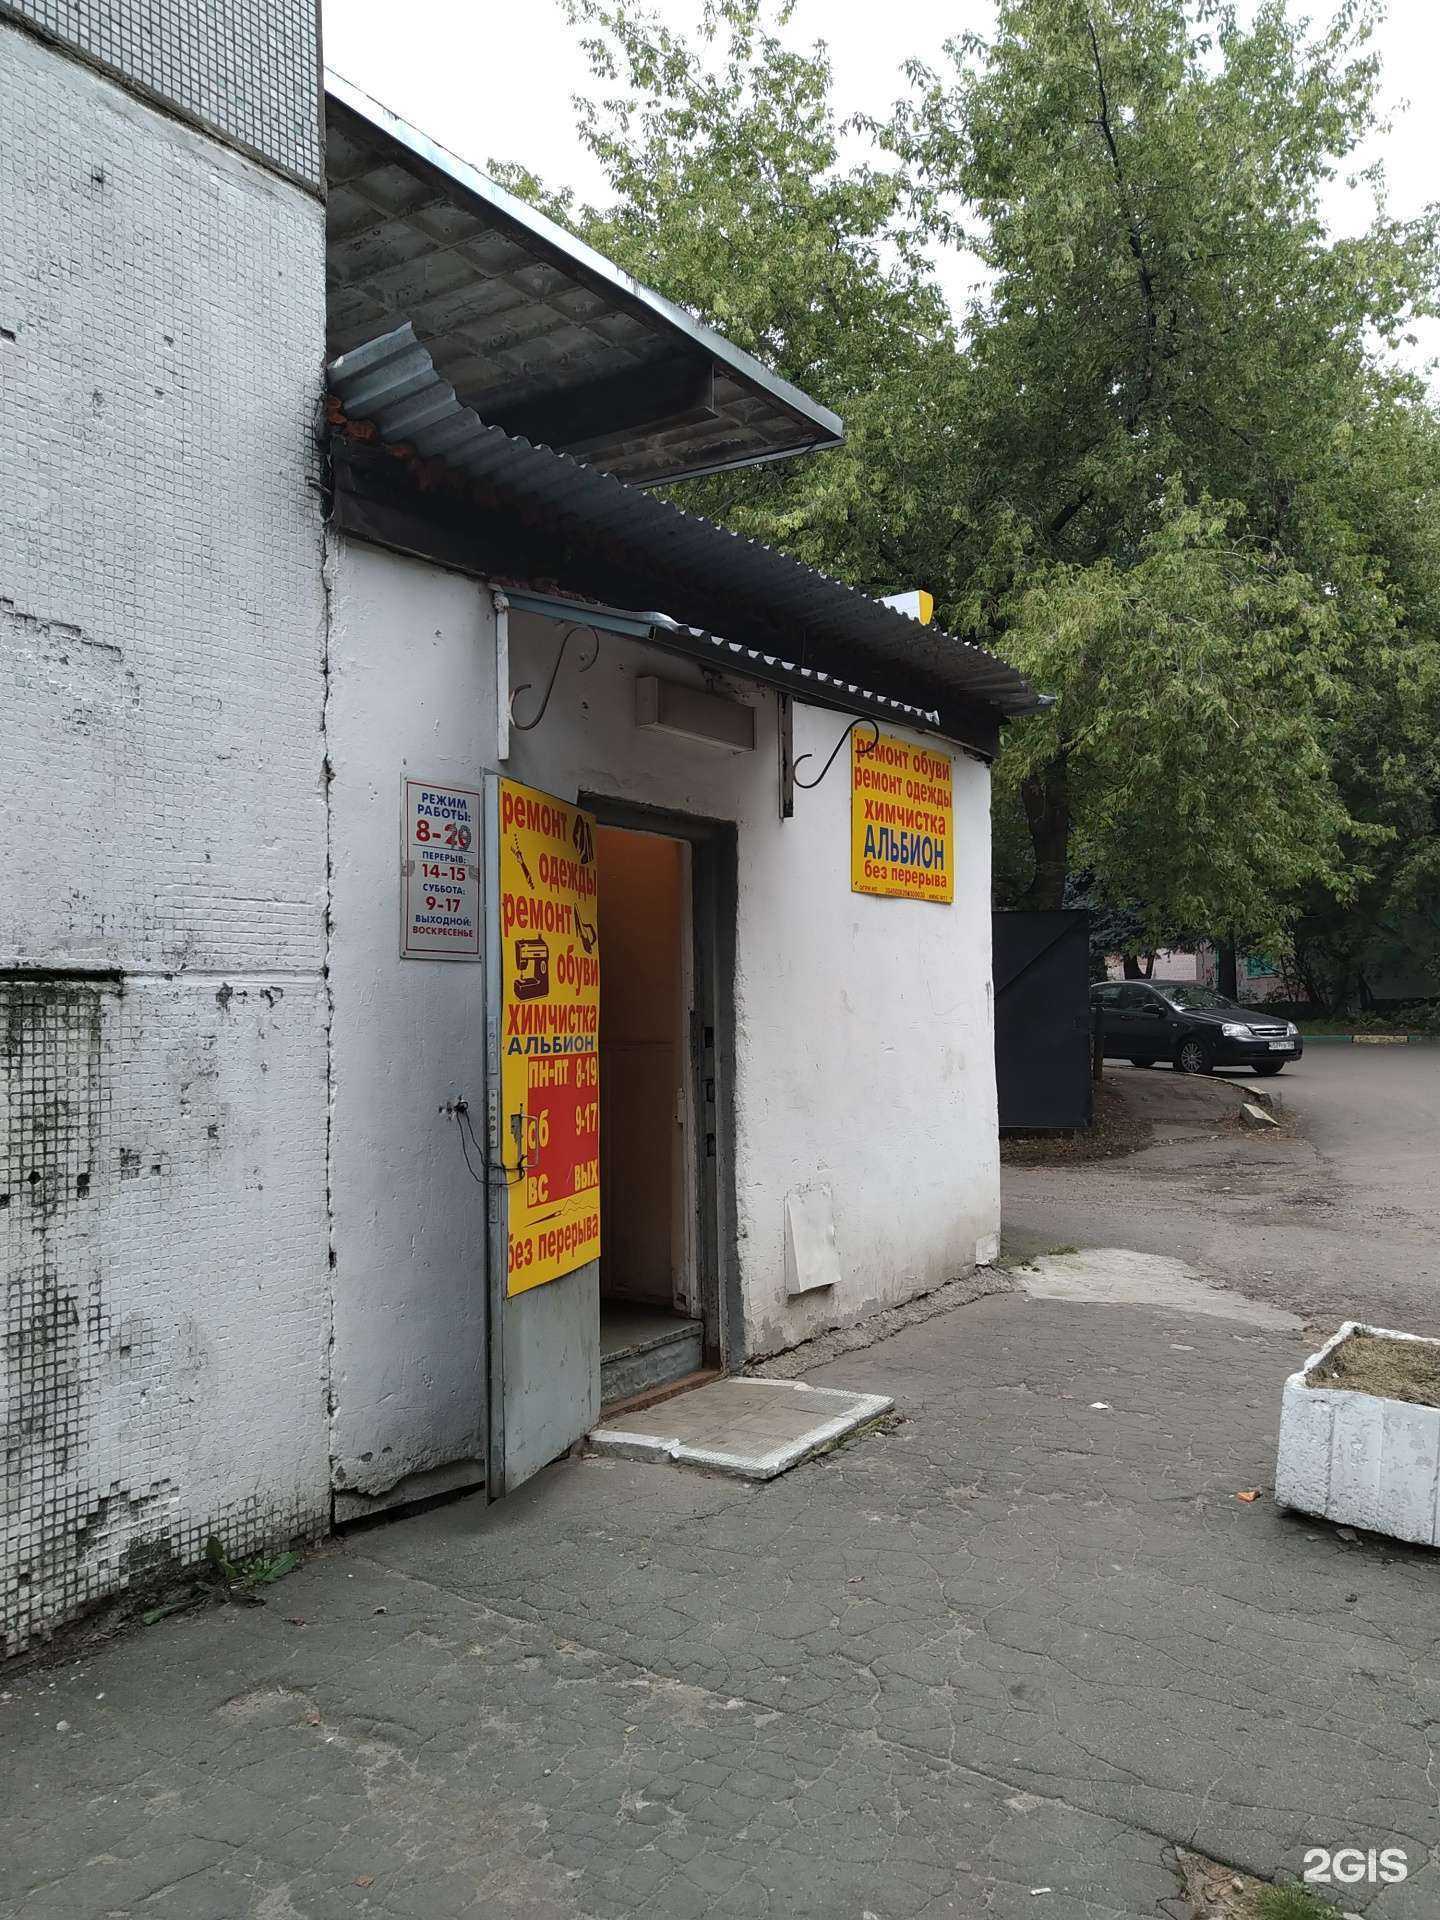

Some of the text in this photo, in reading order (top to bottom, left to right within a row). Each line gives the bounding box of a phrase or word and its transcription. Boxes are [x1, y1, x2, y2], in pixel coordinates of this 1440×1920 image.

[856, 737, 950, 783] ремонт обуви
[421, 792, 467, 810] РЕЖИМ
[854, 764, 952, 810] ремонт одежды
[417, 804, 471, 822] РАБОТЫ:
[502, 790, 568, 837] ремонт
[422, 851, 467, 864] ПЕРЕРЫВ:
[863, 824, 944, 871] АЛЬБИОН
[422, 863, 466, 882] 14-15
[538, 852, 597, 900] одежды
[864, 859, 947, 888] без перерыва
[422, 883, 466, 895] СУББОТА:
[425, 896, 461, 913] 9-17
[502, 893, 572, 938] ремонт
[412, 925, 473, 938] ВОСКРЕСЕНЬЕ
[415, 914, 472, 927] ВЫХОДНОЙ:
[556, 944, 598, 996] обуви
[507, 1035, 595, 1056] АЛЬБИОН
[576, 1057, 597, 1089] 8-19
[575, 1102, 598, 1137] 9-17
[538, 1213, 599, 1264] перерыва
